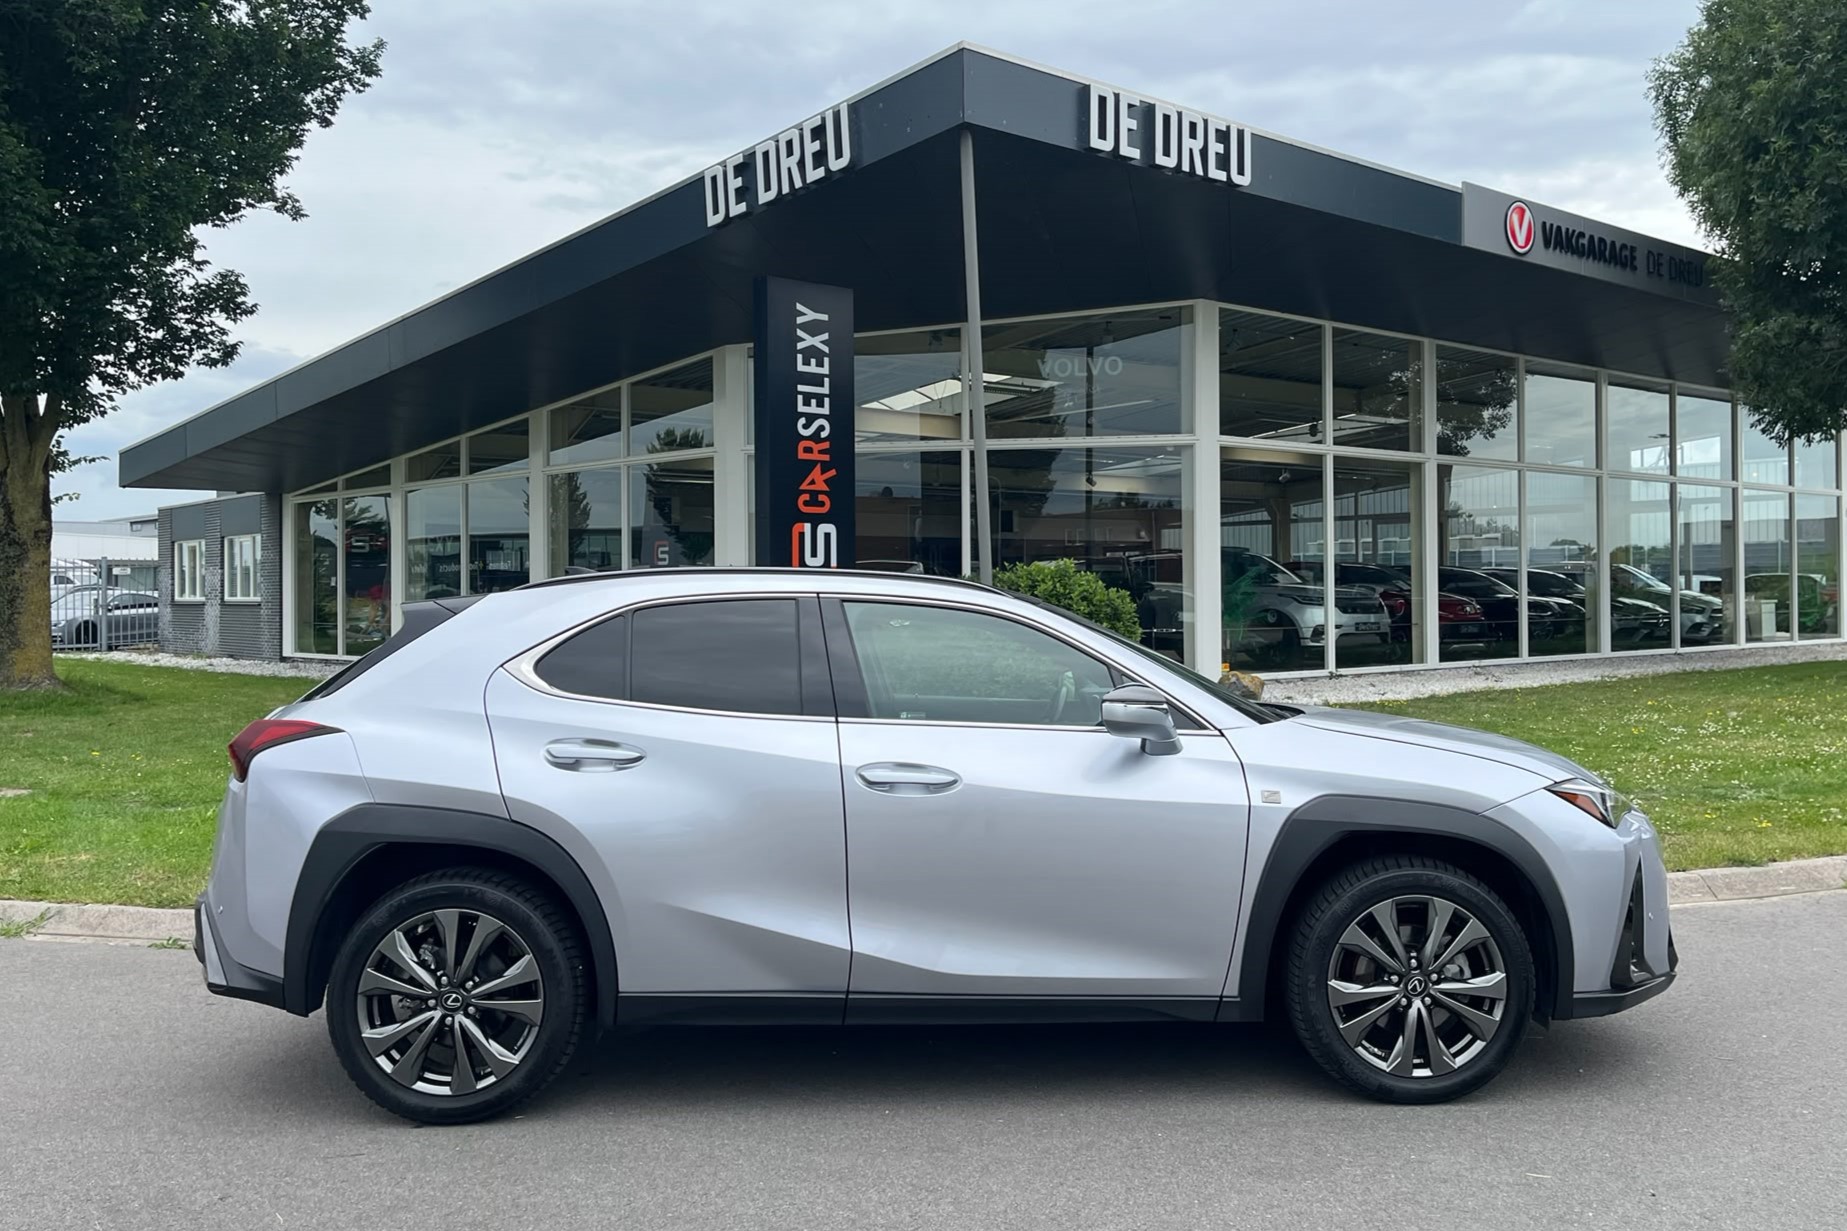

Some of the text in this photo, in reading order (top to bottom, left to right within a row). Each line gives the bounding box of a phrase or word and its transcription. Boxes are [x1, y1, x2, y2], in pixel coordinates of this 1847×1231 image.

[703, 102, 851, 228] DE DREU
[1089, 83, 1252, 187] DE DREU
[1541, 221, 1704, 287] VAKGARAGE DE DREU
[1036, 356, 1123, 378] VOLVO
